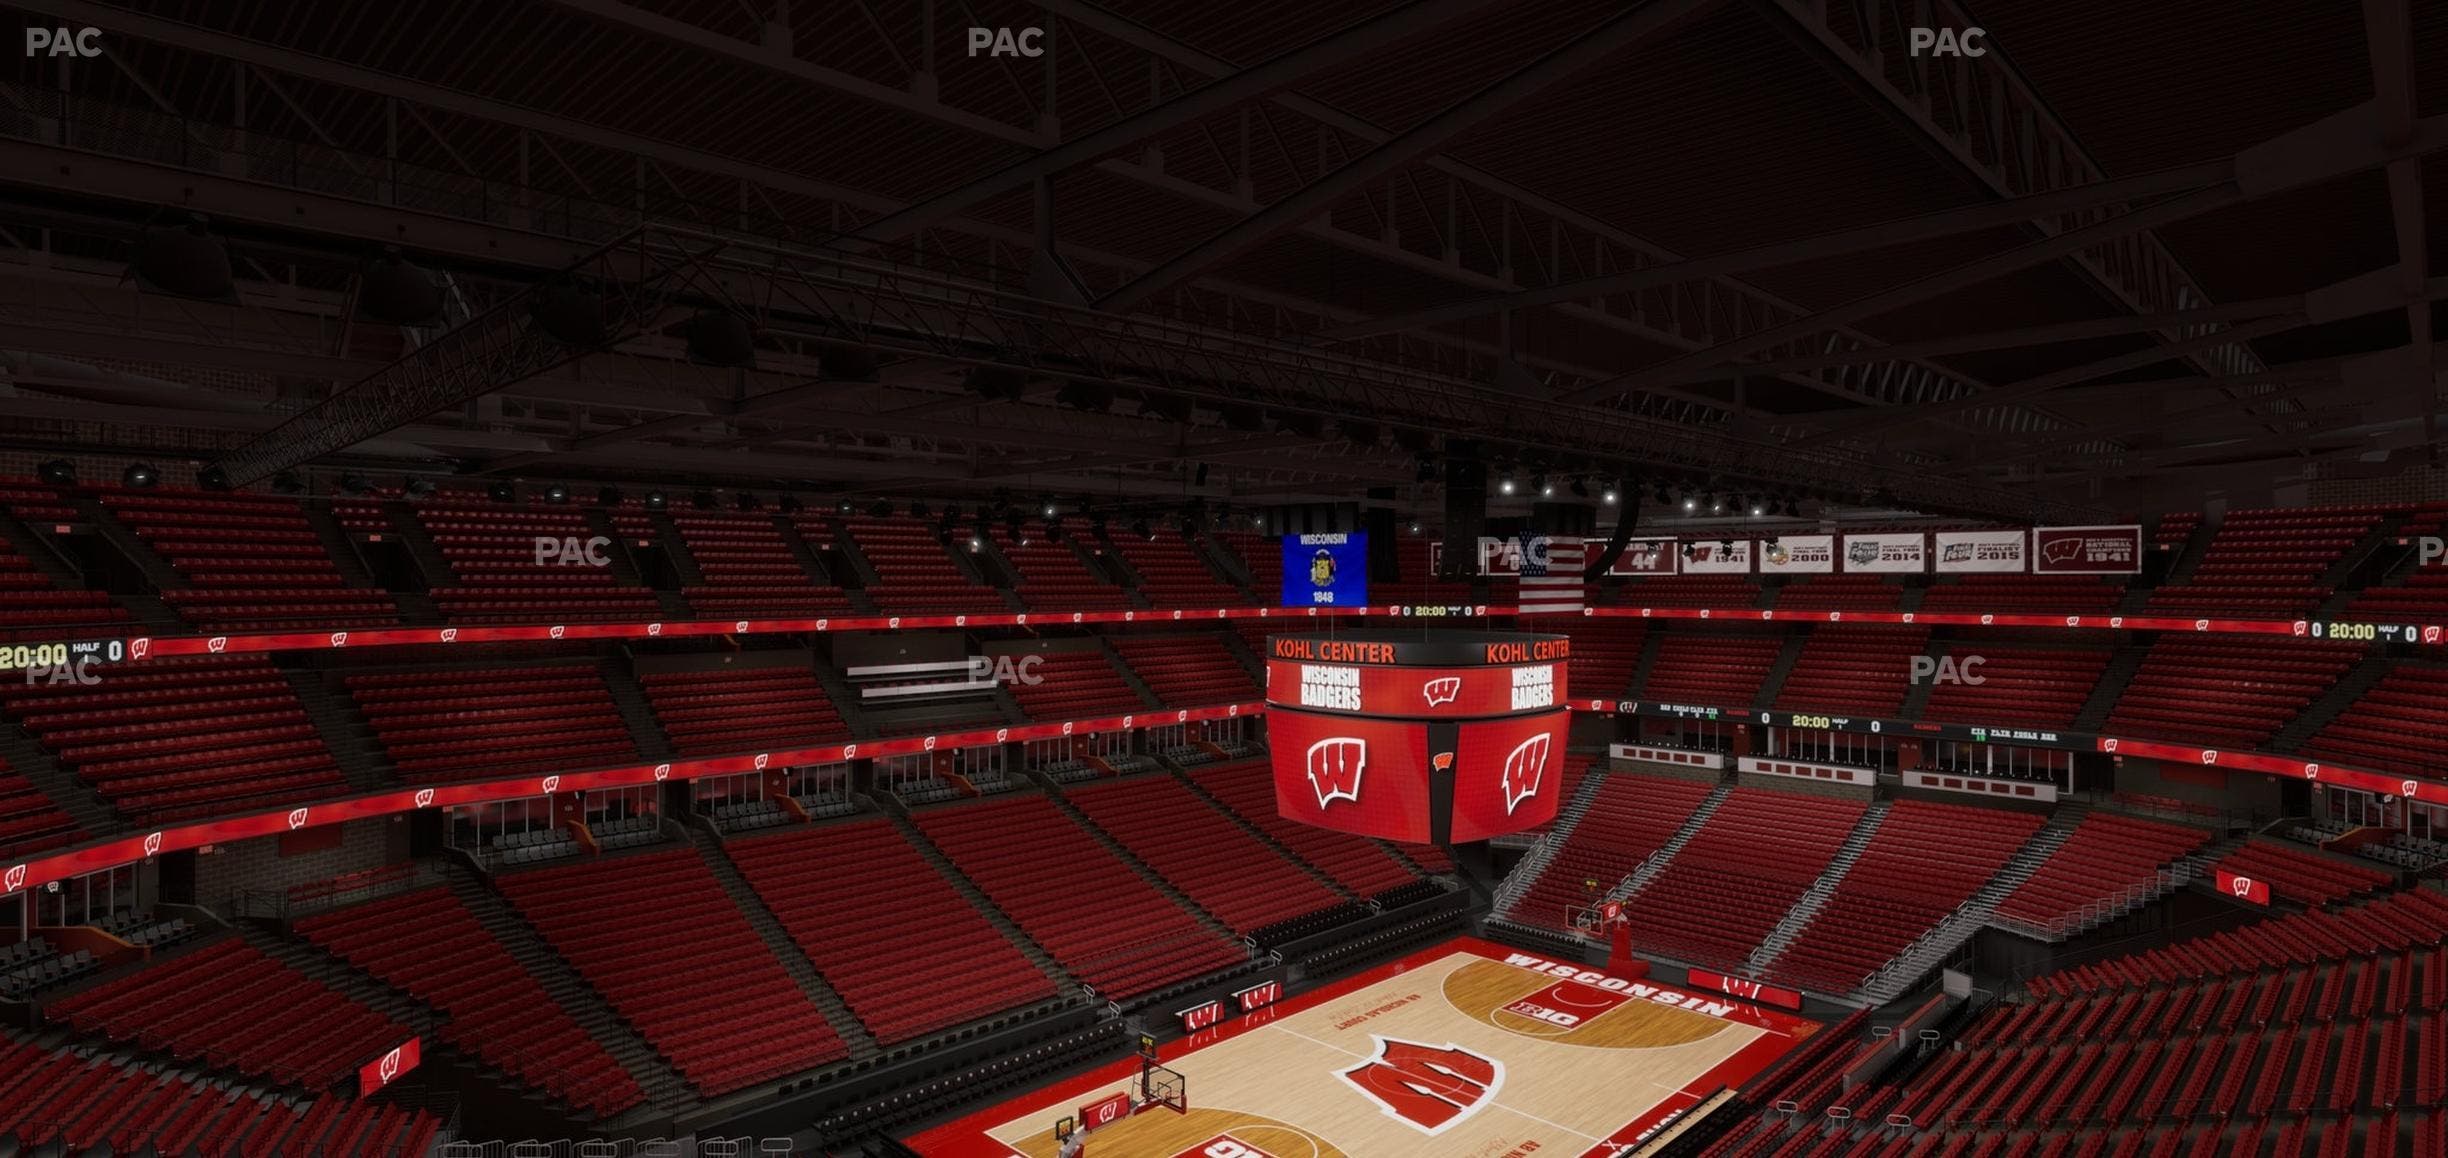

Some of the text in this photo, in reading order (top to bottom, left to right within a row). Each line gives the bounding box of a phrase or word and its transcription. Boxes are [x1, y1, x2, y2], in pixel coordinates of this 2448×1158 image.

[1300, 533, 1348, 545] WISCONSIN
[1631, 552, 1656, 570] 44
[1791, 554, 1829, 562] 2000
[1882, 553, 1920, 561] 2014
[1977, 552, 2020, 560] 2015
[2086, 552, 2131, 562] 1941
[1313, 591, 1334, 604] 1848
[1415, 606, 1447, 617] 20:00
[441, 629, 457, 643] W
[550, 626, 565, 639] W
[648, 624, 662, 636] W
[2312, 622, 2322, 638] 0
[2330, 622, 2375, 640] 20:00
[2406, 626, 2417, 643] 0
[2425, 626, 2440, 643] W
[132, 638, 149, 660] W
[208, 637, 227, 653] W
[332, 632, 348, 648] W
[0, 640, 123, 670] 20:00 HALF 0
[1276, 639, 1396, 663] KOHL CENTER
[1487, 639, 1570, 663] KOHL CENTER
[1301, 664, 1361, 688] WISCONSIN
[1511, 664, 1553, 687] WISCONSIN
[1301, 683, 1362, 711] BADGERS
[1424, 677, 1461, 707] W
[1511, 682, 1554, 711] BADGERS
[1620, 702, 1638, 713] W
[1792, 715, 1830, 729] 20:00
[755, 754, 769, 770] W
[1433, 752, 1454, 772] W
[2202, 750, 2218, 765] W
[655, 764, 671, 782] W
[1307, 737, 1366, 810] W
[1502, 732, 1551, 816] W
[2305, 764, 2319, 779] W
[543, 776, 560, 794] W
[2402, 780, 2418, 797] W
[415, 789, 435, 809] W
[289, 808, 308, 830] W
[145, 832, 162, 857] W
[5, 864, 27, 892] W
[2234, 877, 2251, 897] W
[1503, 953, 1736, 1017] WISCONSIN
[380, 1048, 401, 1085] W
[1330, 1034, 1506, 1137] W
[1100, 1102, 1118, 1123] W
